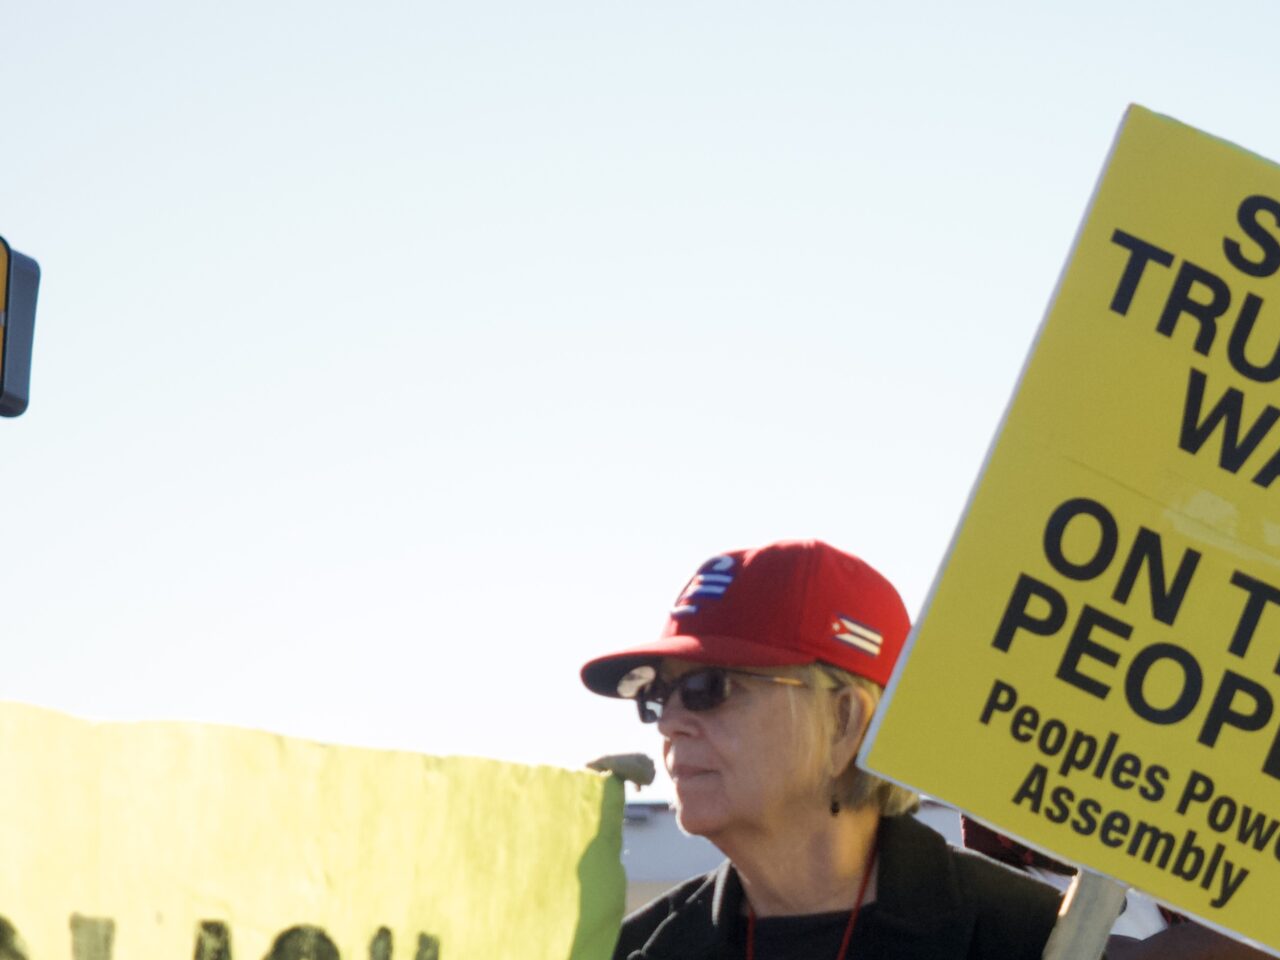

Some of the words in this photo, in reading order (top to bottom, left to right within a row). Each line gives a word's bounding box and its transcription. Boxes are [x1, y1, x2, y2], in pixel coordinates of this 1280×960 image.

[1041, 497, 1201, 627] ON
[979, 680, 1169, 804] Peoples
[1012, 763, 1249, 909] Assembly
